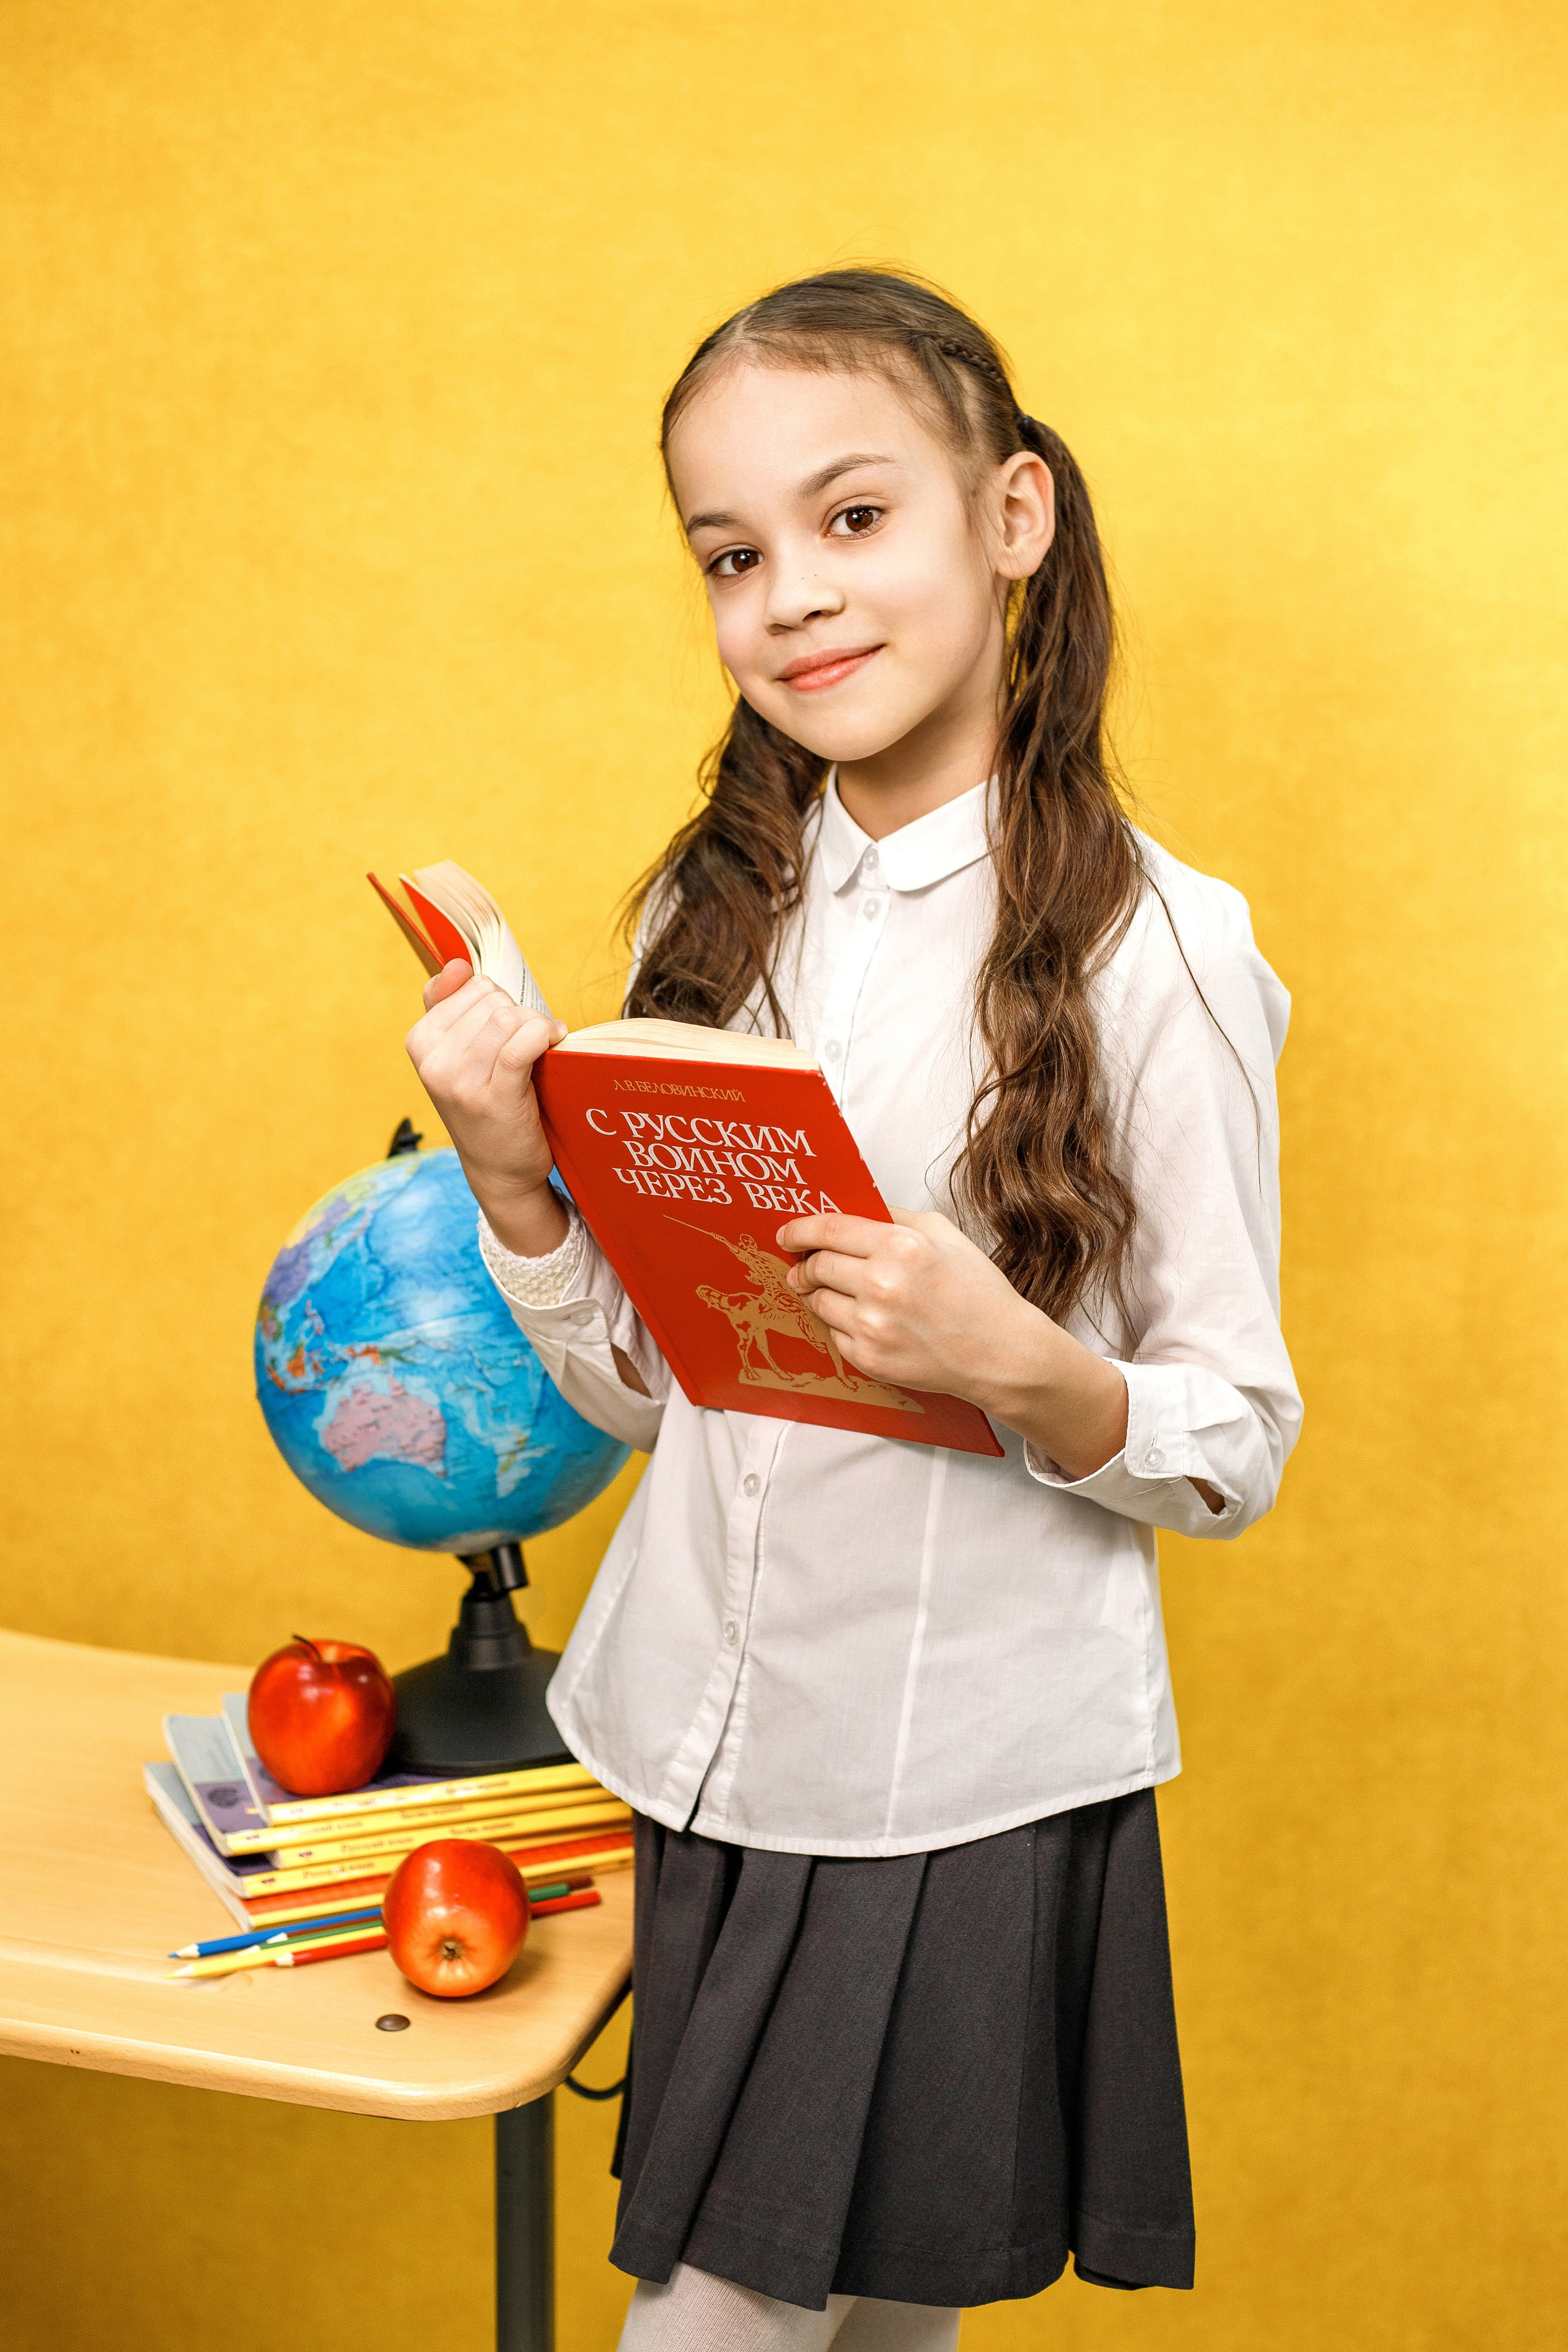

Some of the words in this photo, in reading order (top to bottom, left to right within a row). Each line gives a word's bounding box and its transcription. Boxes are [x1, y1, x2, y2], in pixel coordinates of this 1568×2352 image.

[586, 1108, 617, 1136] С
[619, 1110, 817, 1157] РУССКИМ
[621, 1140, 809, 1185] ВОИНОМ
[611, 1167, 733, 1205] ЧЕРЕЗ
[740, 1181, 844, 1215] ВЕКА
